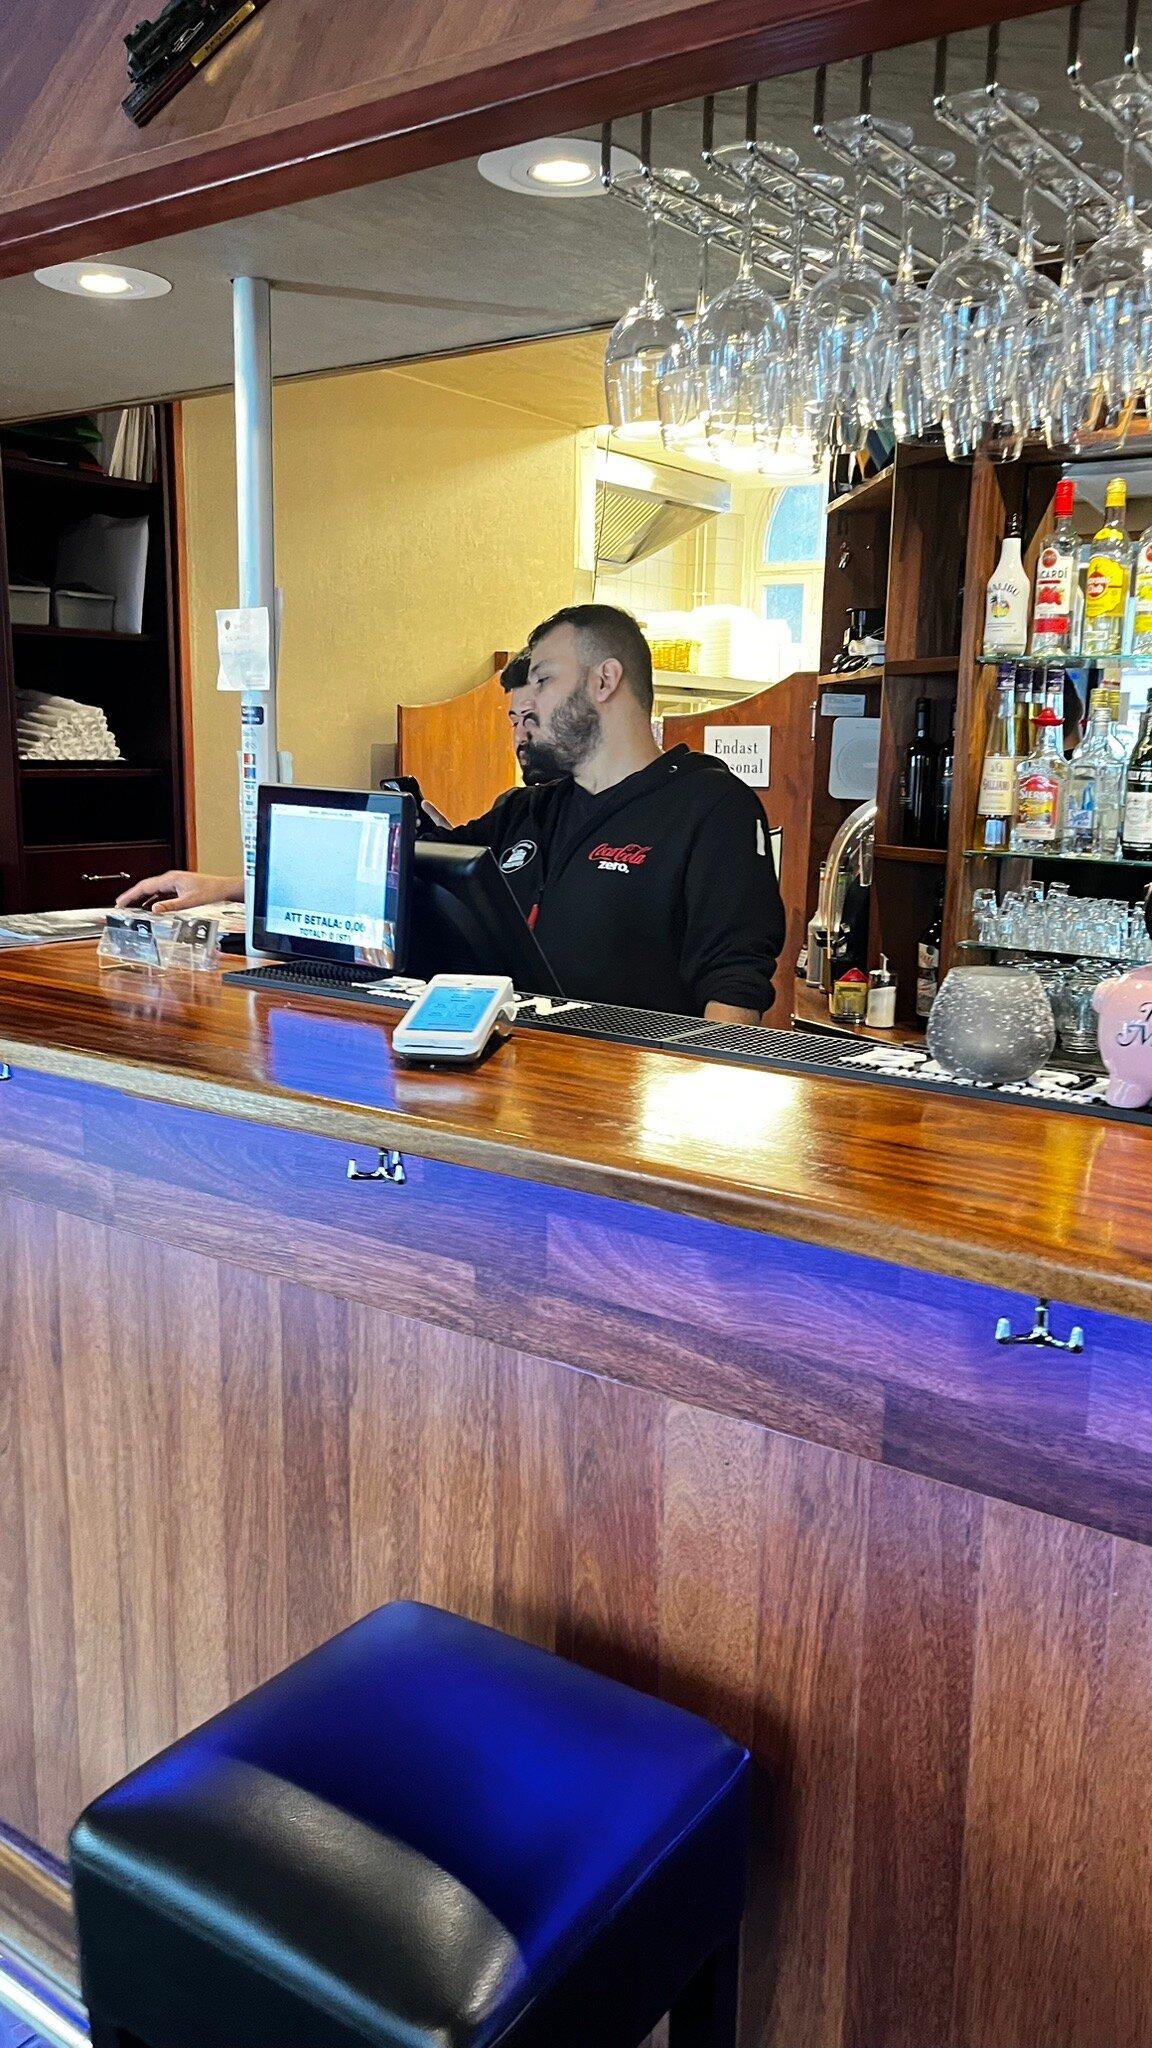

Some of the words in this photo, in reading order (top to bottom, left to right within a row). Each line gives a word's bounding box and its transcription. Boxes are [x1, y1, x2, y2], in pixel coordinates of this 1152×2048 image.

[714, 738, 758, 755] Endast
[730, 758, 764, 774] sonal
[284, 911, 303, 923] ATT
[304, 914, 343, 929] BETALA:
